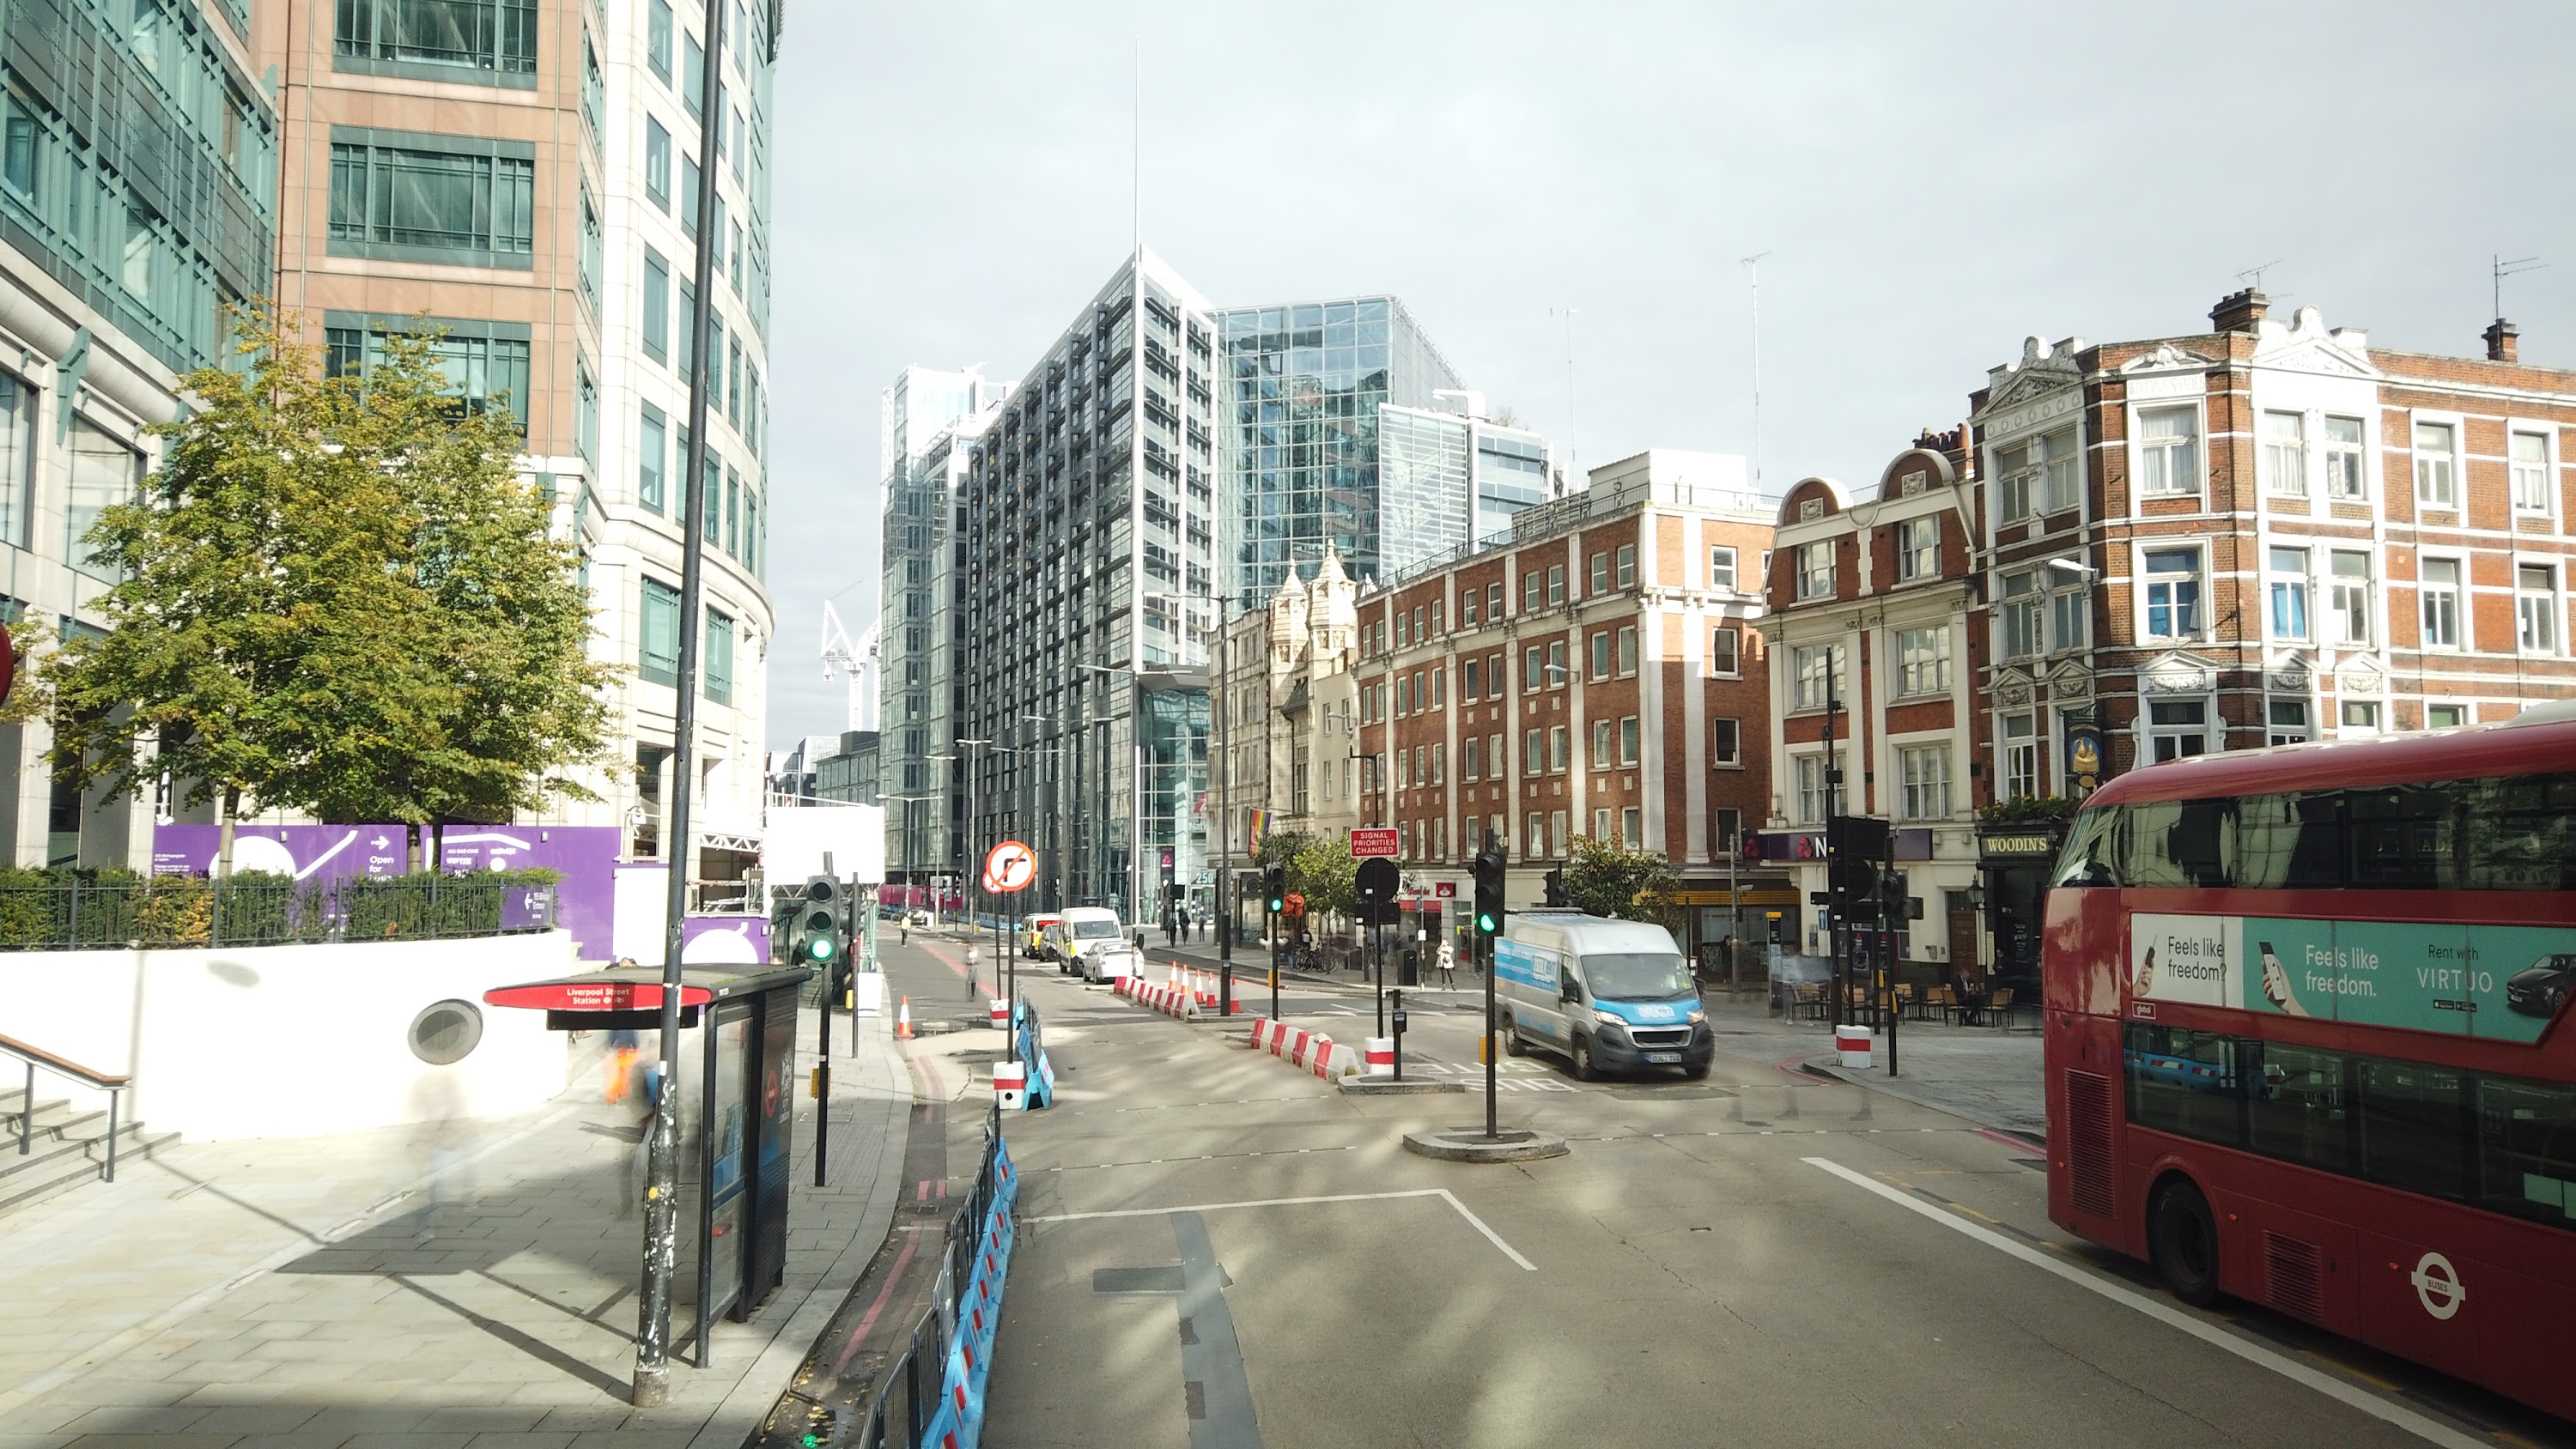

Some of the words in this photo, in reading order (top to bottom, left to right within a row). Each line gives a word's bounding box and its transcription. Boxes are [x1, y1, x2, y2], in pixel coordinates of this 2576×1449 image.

[1987, 837, 2047, 852] WOODIN'S
[369, 855, 394, 864] Open
[1196, 873, 1214, 884] 250
[2168, 936, 2199, 955] Feels
[2202, 937, 2225, 957] like
[2428, 944, 2453, 959] Rent
[2457, 947, 2479, 961] wth
[2306, 944, 2348, 968] Feels
[2352, 947, 2379, 970] like
[2168, 959, 2227, 981] freedom?
[2306, 970, 2377, 997] freedom.
[2416, 967, 2493, 993] VIRTUO
[567, 988, 603, 997] Liverpool
[2427, 1279, 2448, 1293] BUSES
